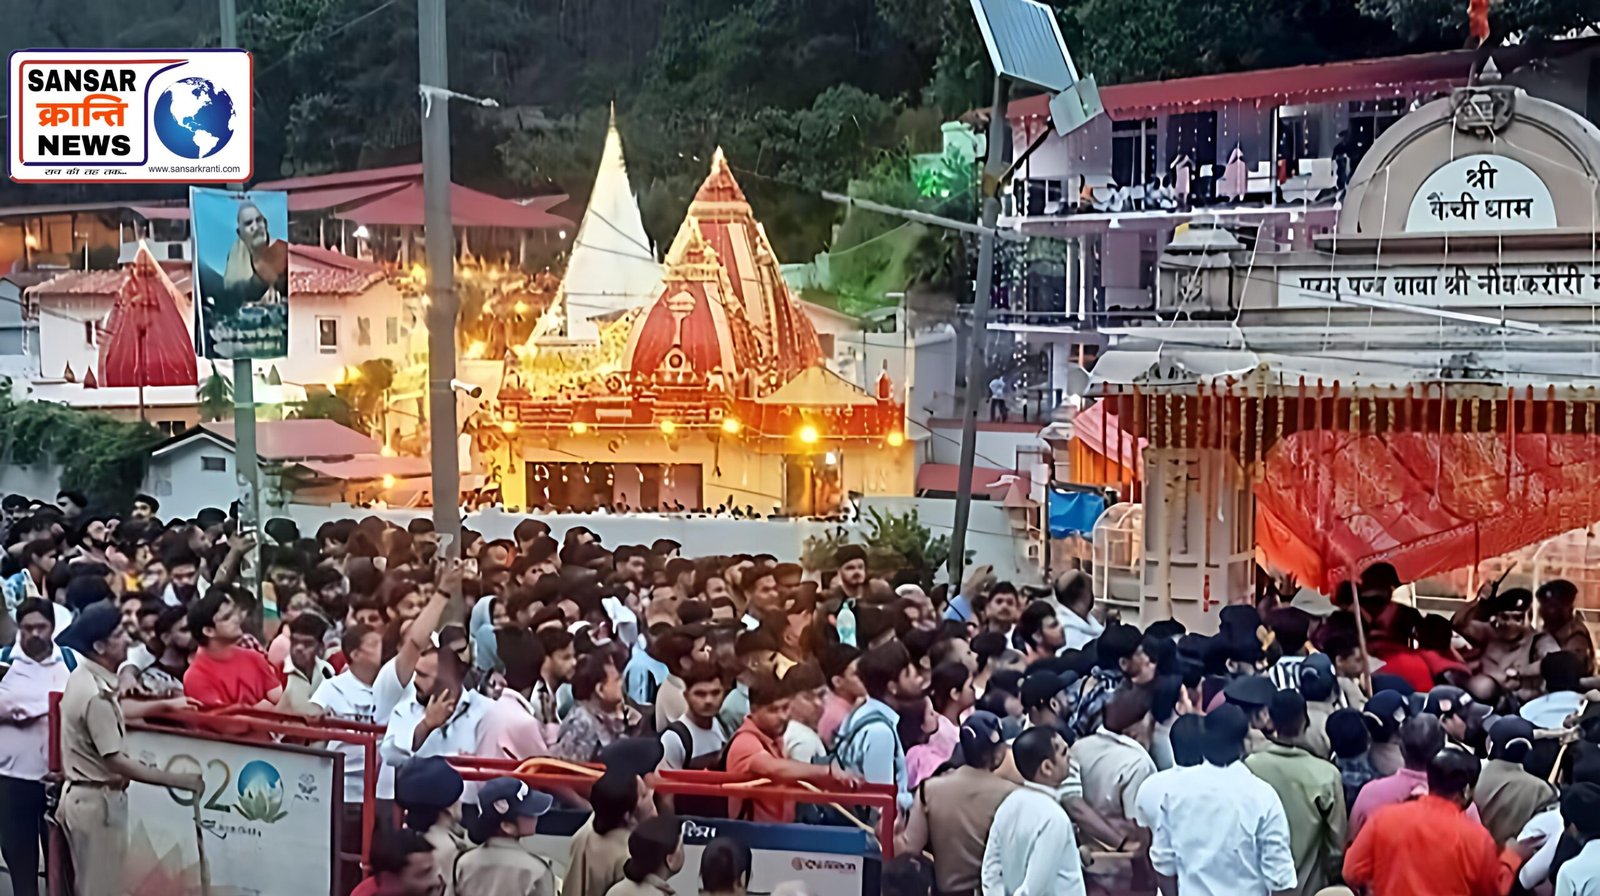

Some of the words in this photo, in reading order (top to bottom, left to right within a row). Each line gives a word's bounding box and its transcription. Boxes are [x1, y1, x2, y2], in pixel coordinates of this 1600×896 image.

[1466, 160, 1498, 190] श्री
[1485, 198, 1534, 220] धाम
[1445, 266, 1471, 295] श्री
